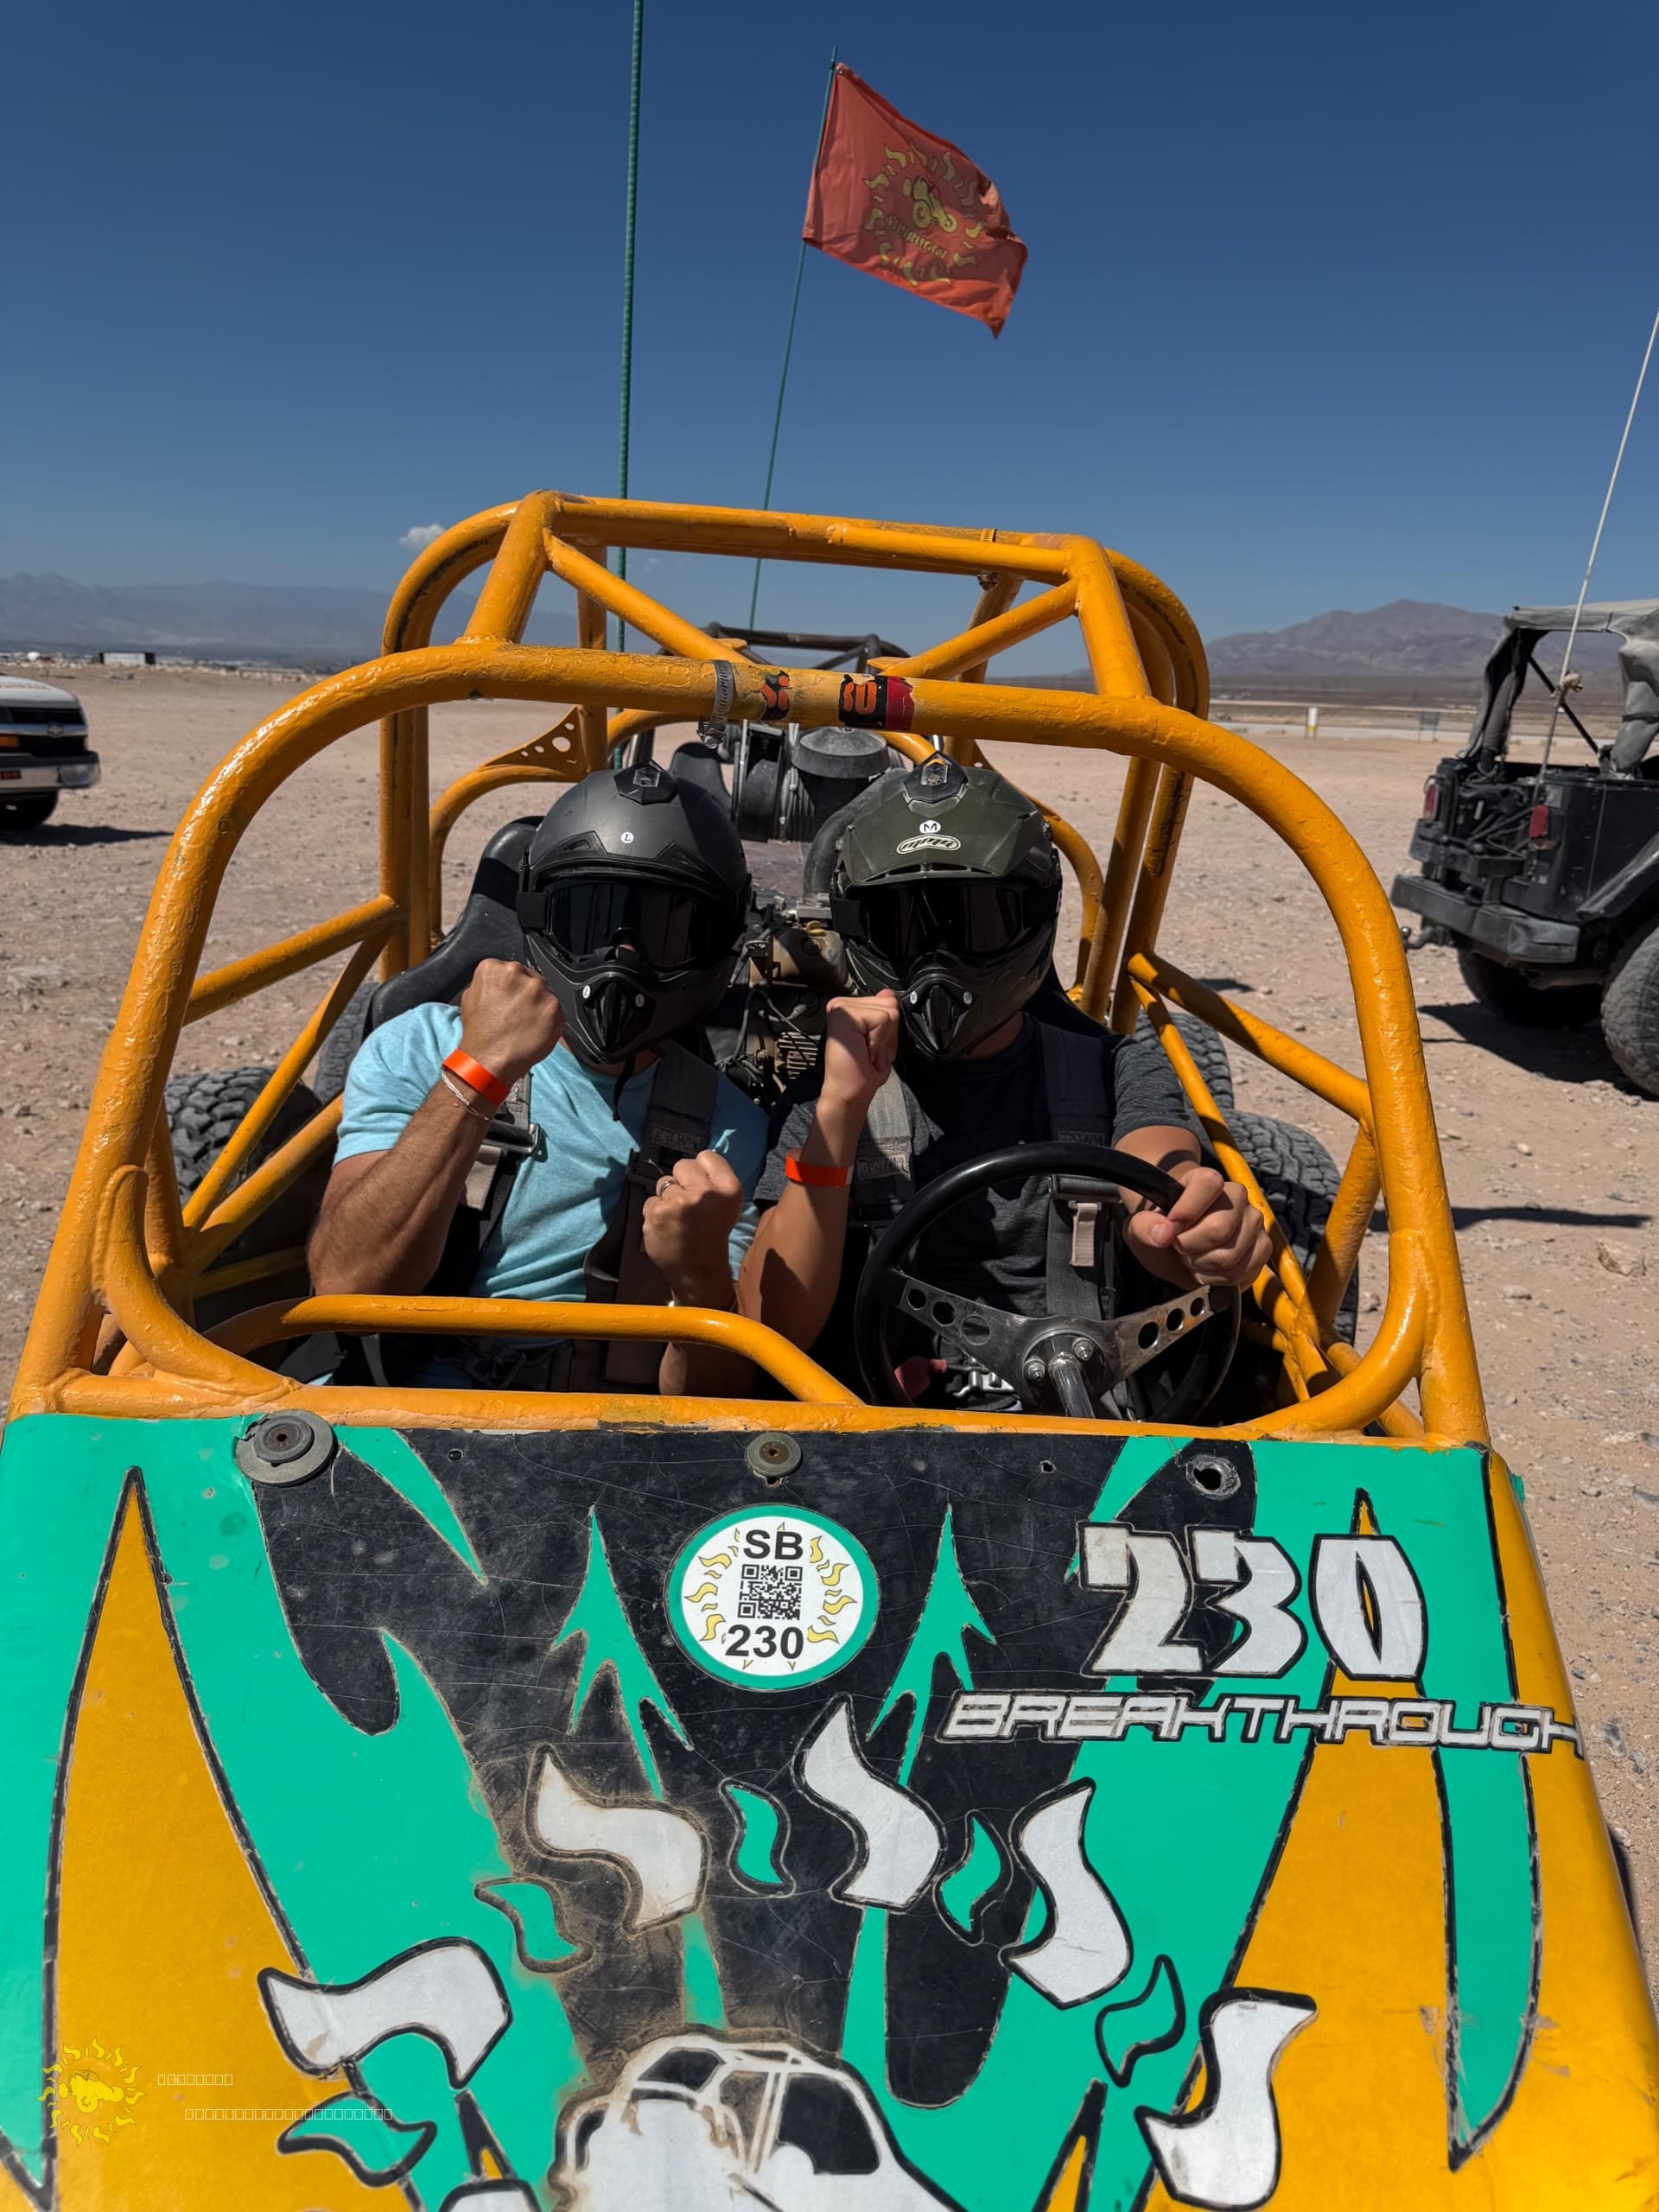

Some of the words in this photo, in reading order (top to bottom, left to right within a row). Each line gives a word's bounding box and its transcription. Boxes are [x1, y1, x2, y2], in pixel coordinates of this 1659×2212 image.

[923, 822, 938, 831] M
[743, 1529, 804, 1560] SB
[1084, 1525, 1427, 1679] 230
[725, 1624, 804, 1660] 230
[942, 1693, 1585, 1759] BREAKTHROUGH
